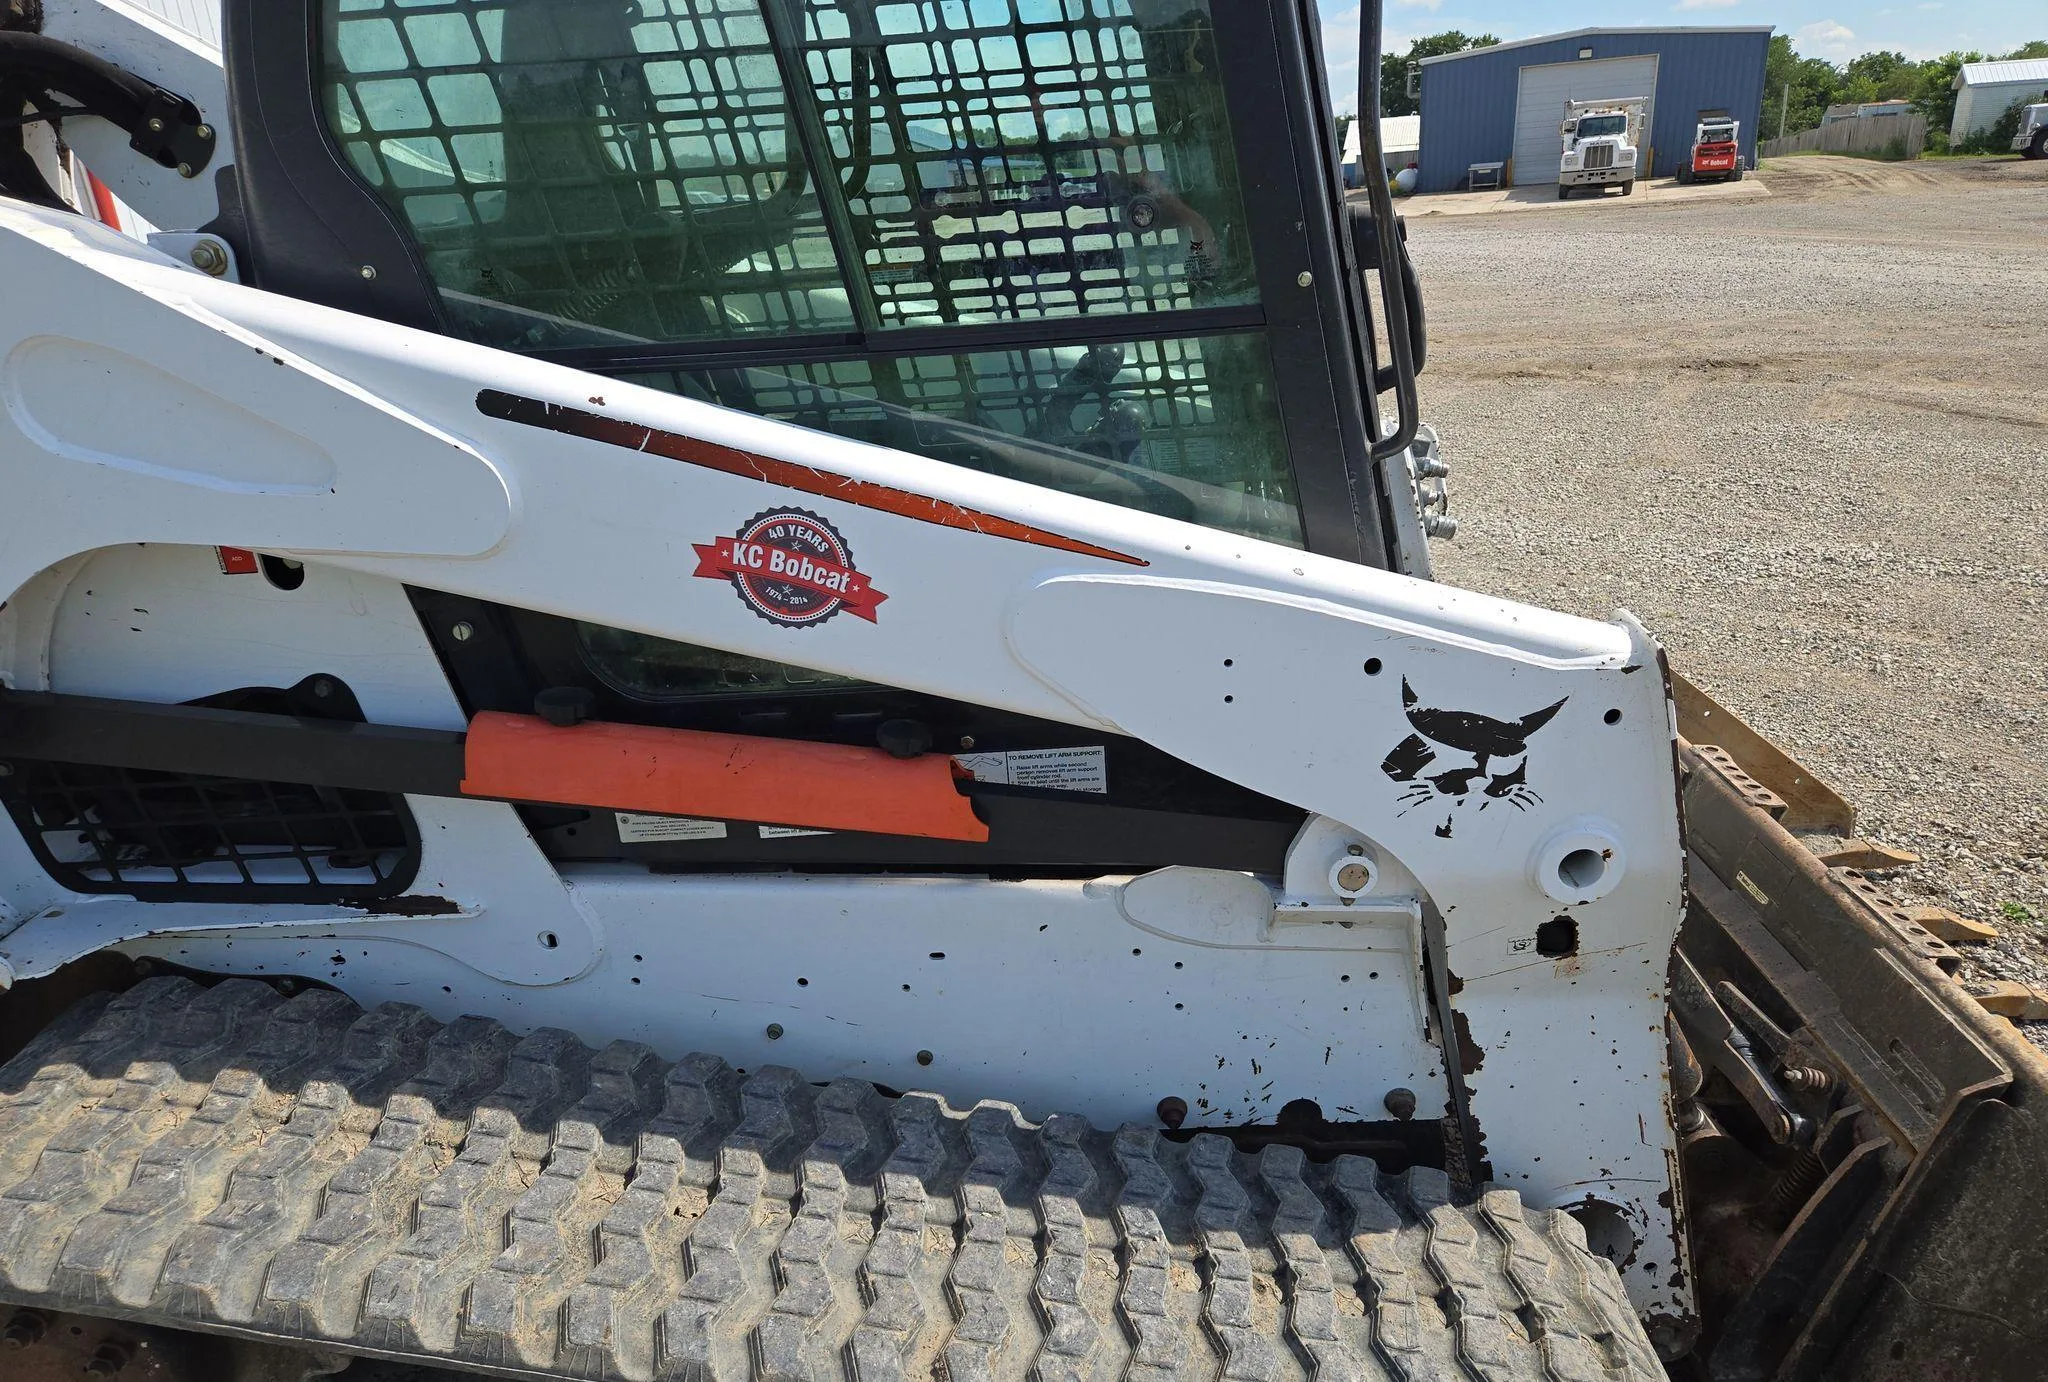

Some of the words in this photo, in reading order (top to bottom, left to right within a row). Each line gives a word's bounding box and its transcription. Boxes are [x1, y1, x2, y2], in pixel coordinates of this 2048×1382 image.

[1710, 158, 1728, 166] Bobcat
[768, 525, 785, 539] 40
[788, 524, 829, 552] YEARS
[732, 542, 764, 568] KC
[769, 549, 851, 593] Bobcat
[765, 586, 782, 601] 1974
